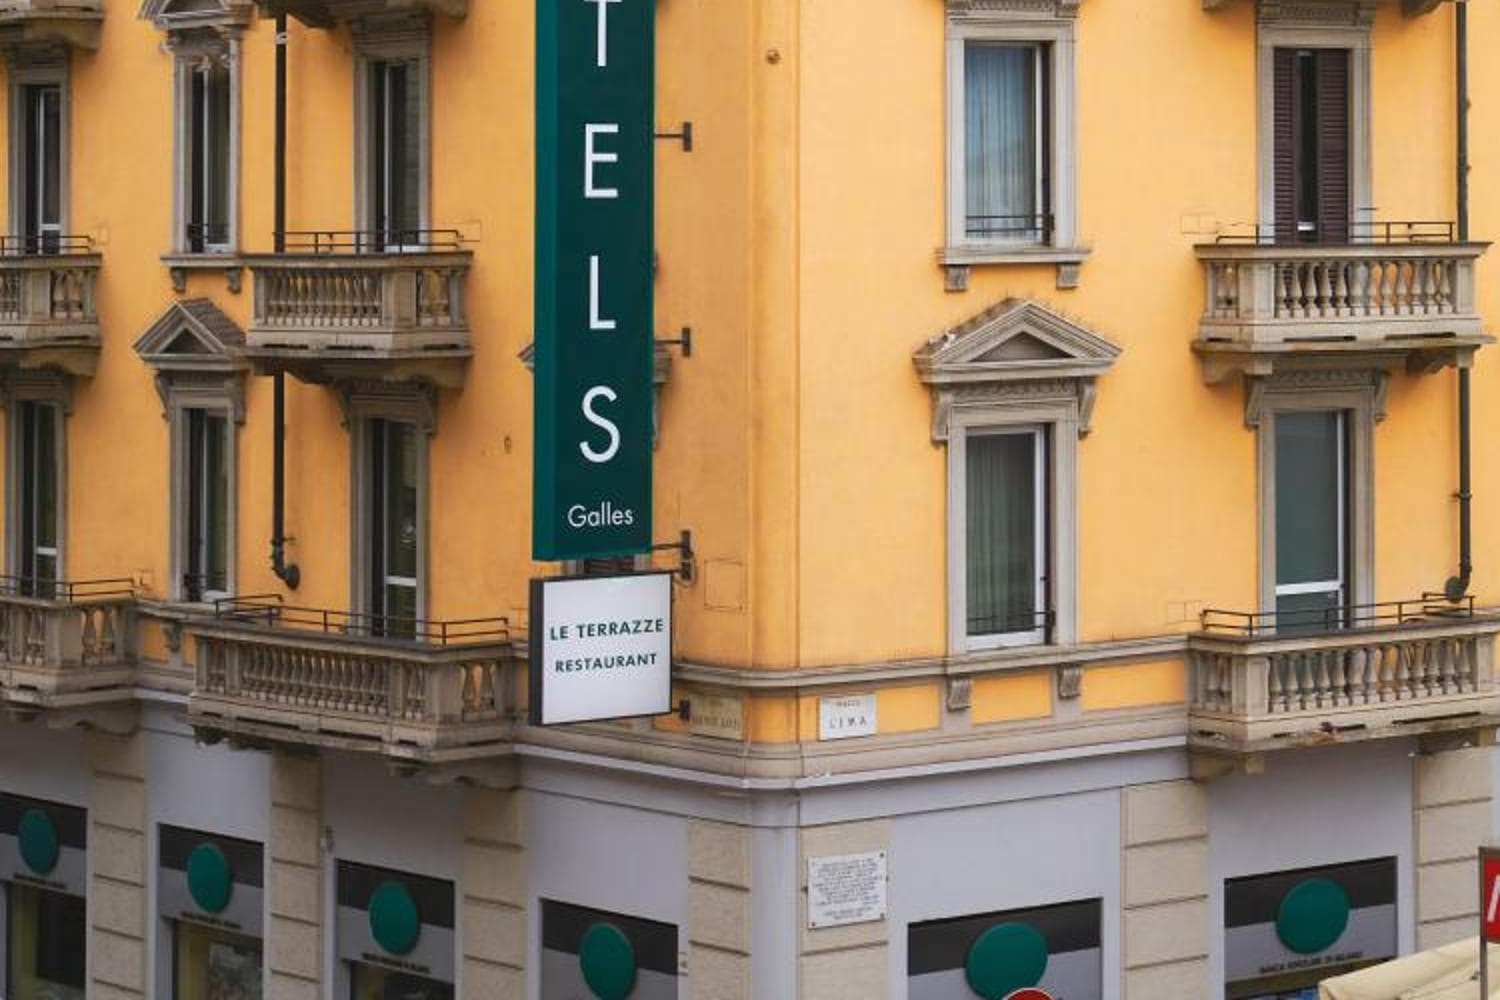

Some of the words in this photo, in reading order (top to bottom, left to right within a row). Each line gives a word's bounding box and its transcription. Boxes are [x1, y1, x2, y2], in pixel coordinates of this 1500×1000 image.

[567, 501, 634, 527] Galles
[549, 625, 569, 641] LE
[576, 618, 664, 639] TERRAZZE
[555, 653, 657, 673] RESTAURANT
